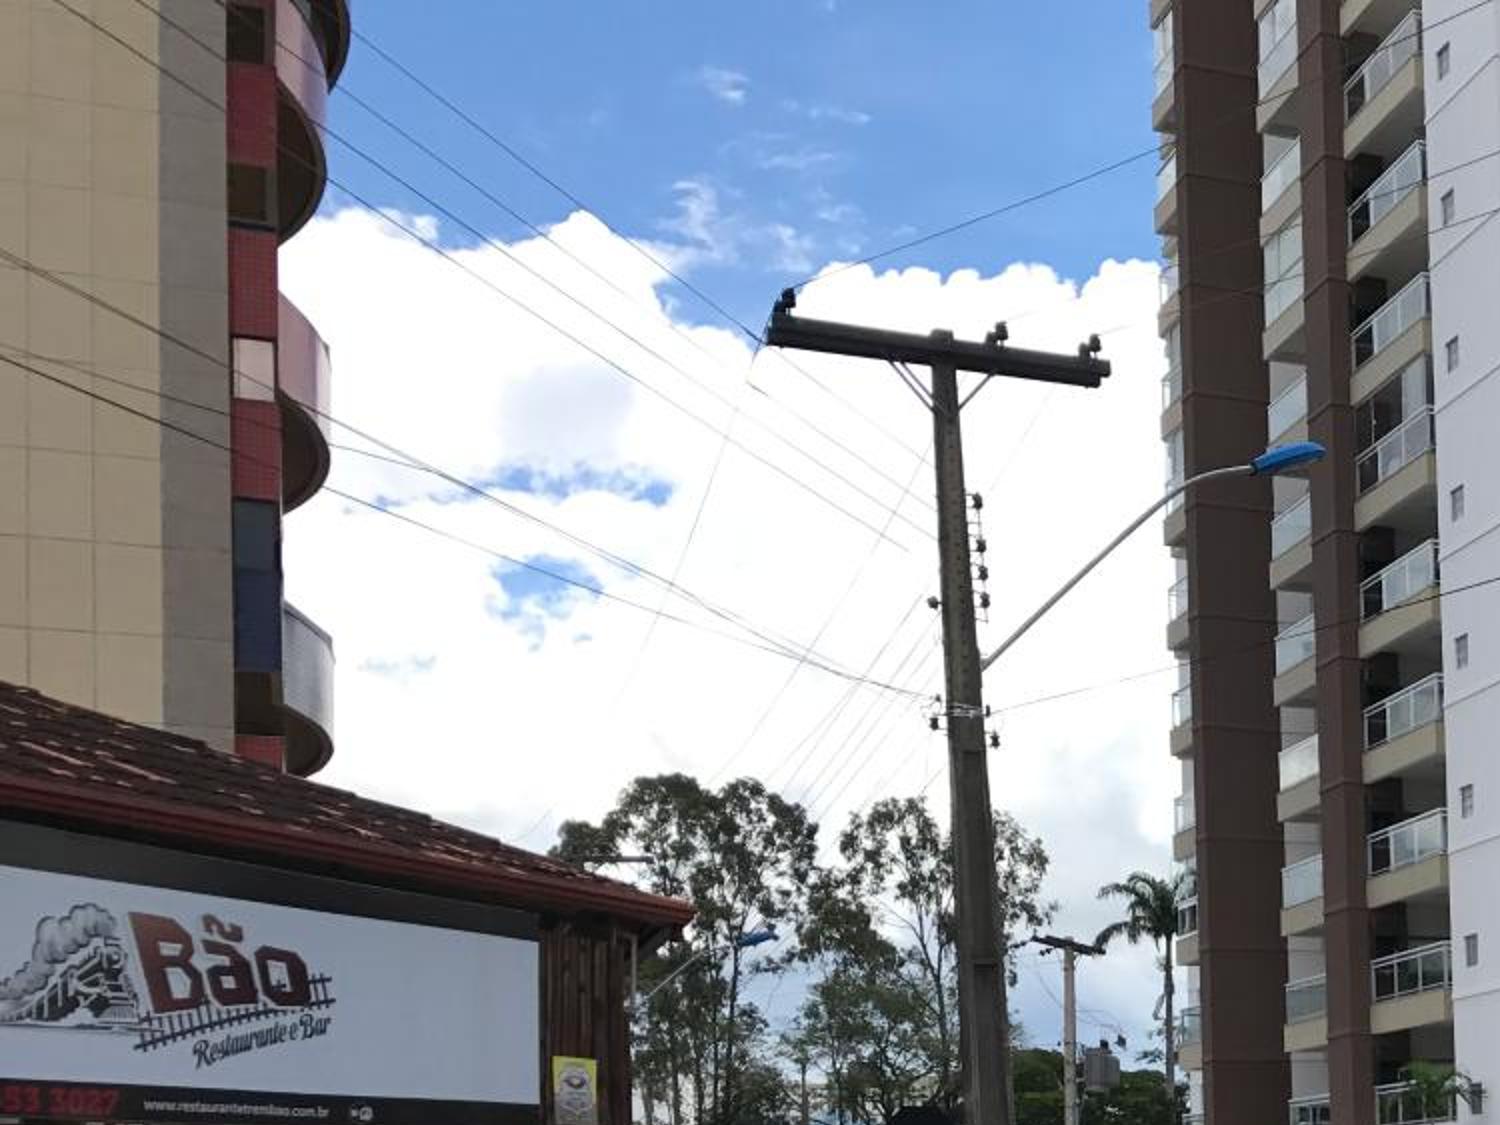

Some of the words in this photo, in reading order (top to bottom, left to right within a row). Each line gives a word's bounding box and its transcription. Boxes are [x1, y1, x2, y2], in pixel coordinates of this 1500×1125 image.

[127, 911, 312, 1014] Bão
[192, 1019, 285, 1071] Restaurante
[289, 1021, 300, 1041] e
[299, 1012, 332, 1041] Bar
